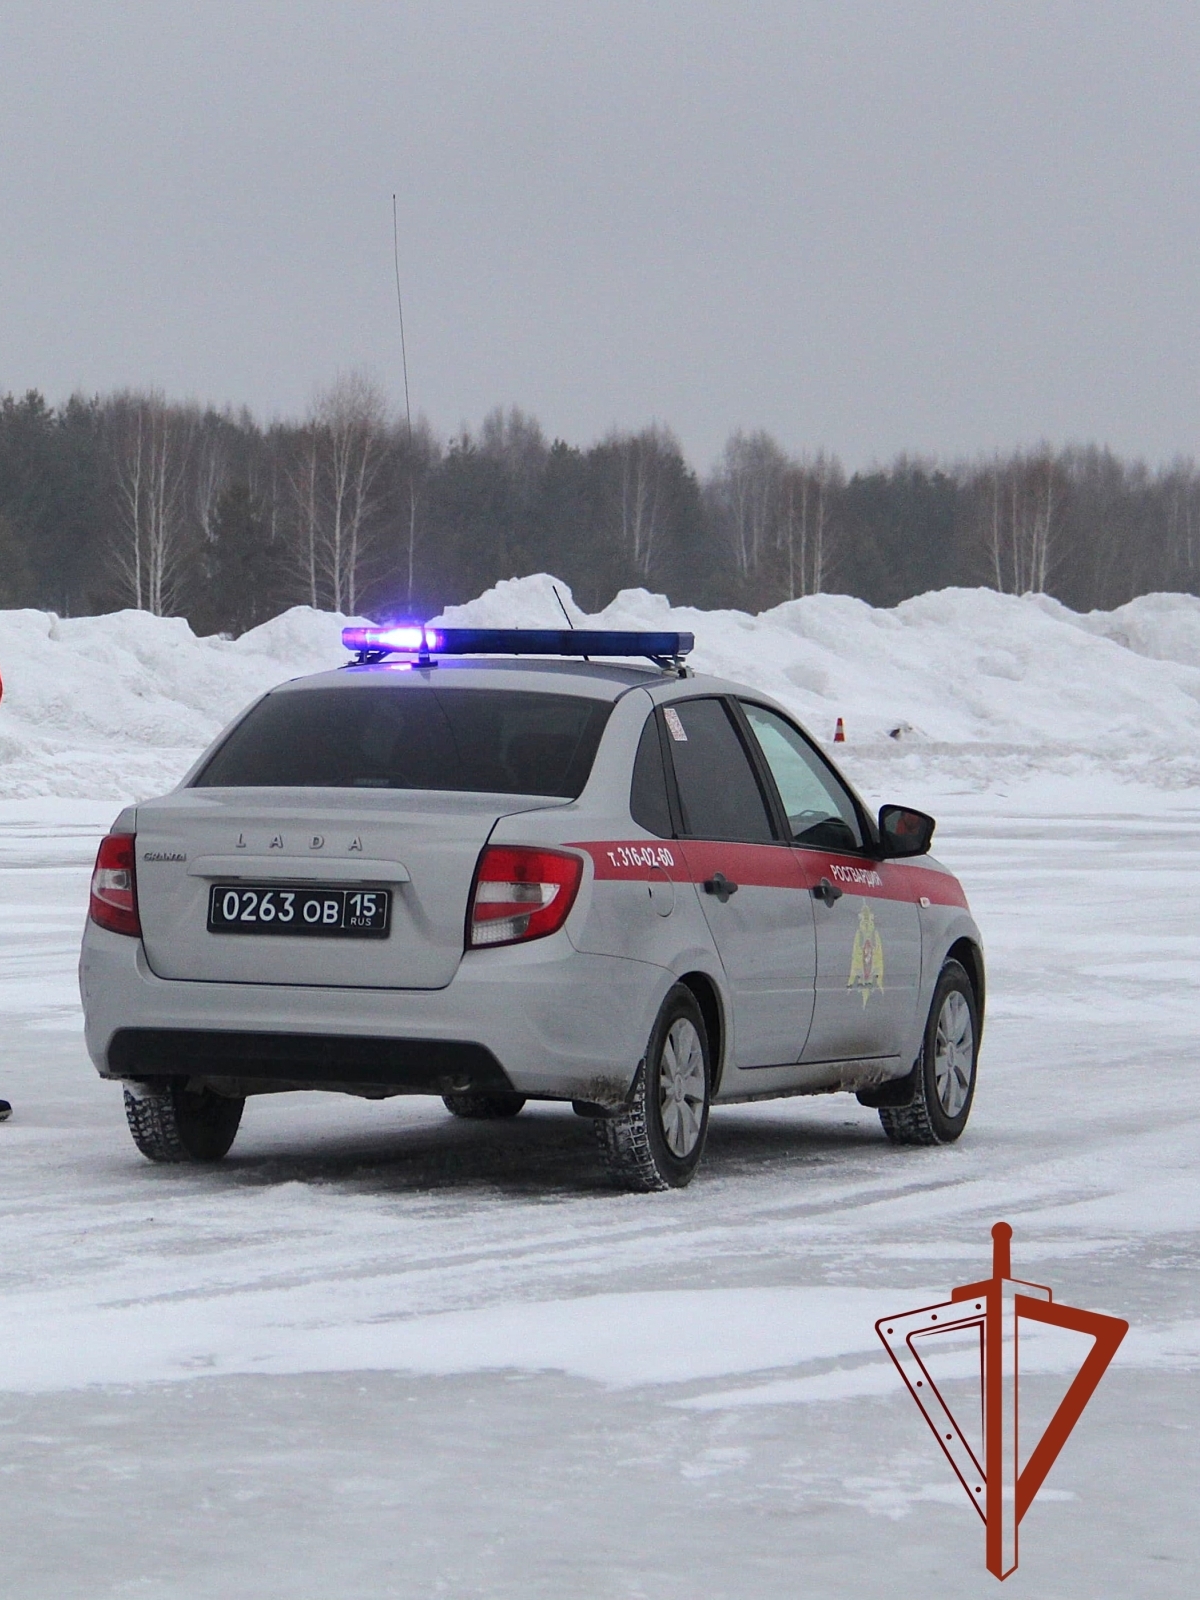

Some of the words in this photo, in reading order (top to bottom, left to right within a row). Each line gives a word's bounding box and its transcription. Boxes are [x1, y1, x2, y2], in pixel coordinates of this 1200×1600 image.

[235, 833, 363, 851] LADA
[143, 852, 187, 861] GRANTA
[618, 847, 674, 867] 316-02-60
[830, 864, 883, 888] РОСГВАРДИЯ
[222, 891, 295, 922] 0263
[350, 894, 377, 917] 15
[350, 917, 372, 926] RUS
